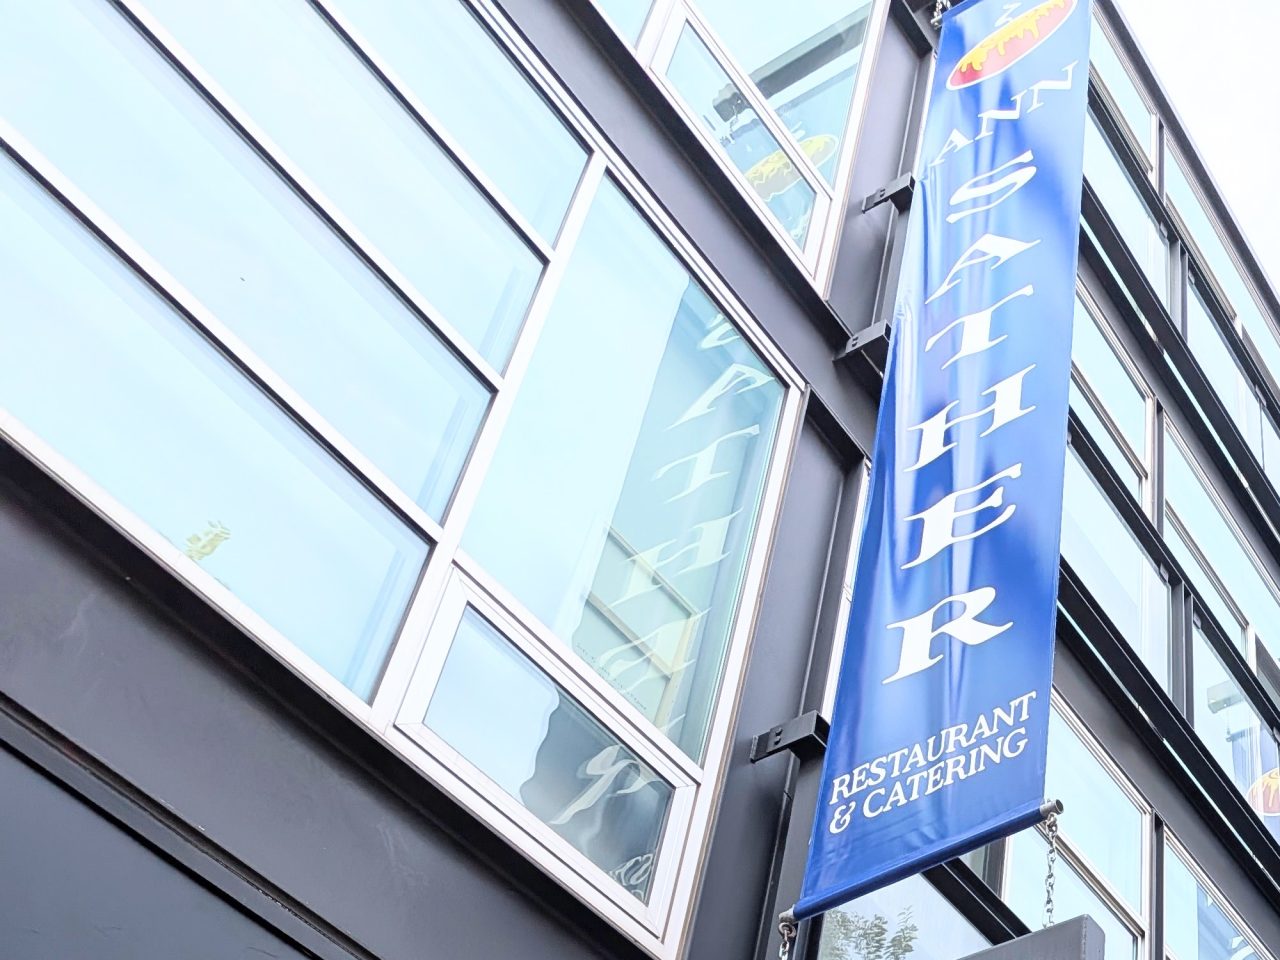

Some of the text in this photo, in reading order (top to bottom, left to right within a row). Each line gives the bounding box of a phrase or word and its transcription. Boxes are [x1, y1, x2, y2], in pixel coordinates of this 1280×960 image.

[929, 61, 1078, 167] ANN
[882, 149, 1041, 685] SATHER
[829, 691, 1037, 805] RESTAURANT
[829, 728, 1029, 834] & CATERING
